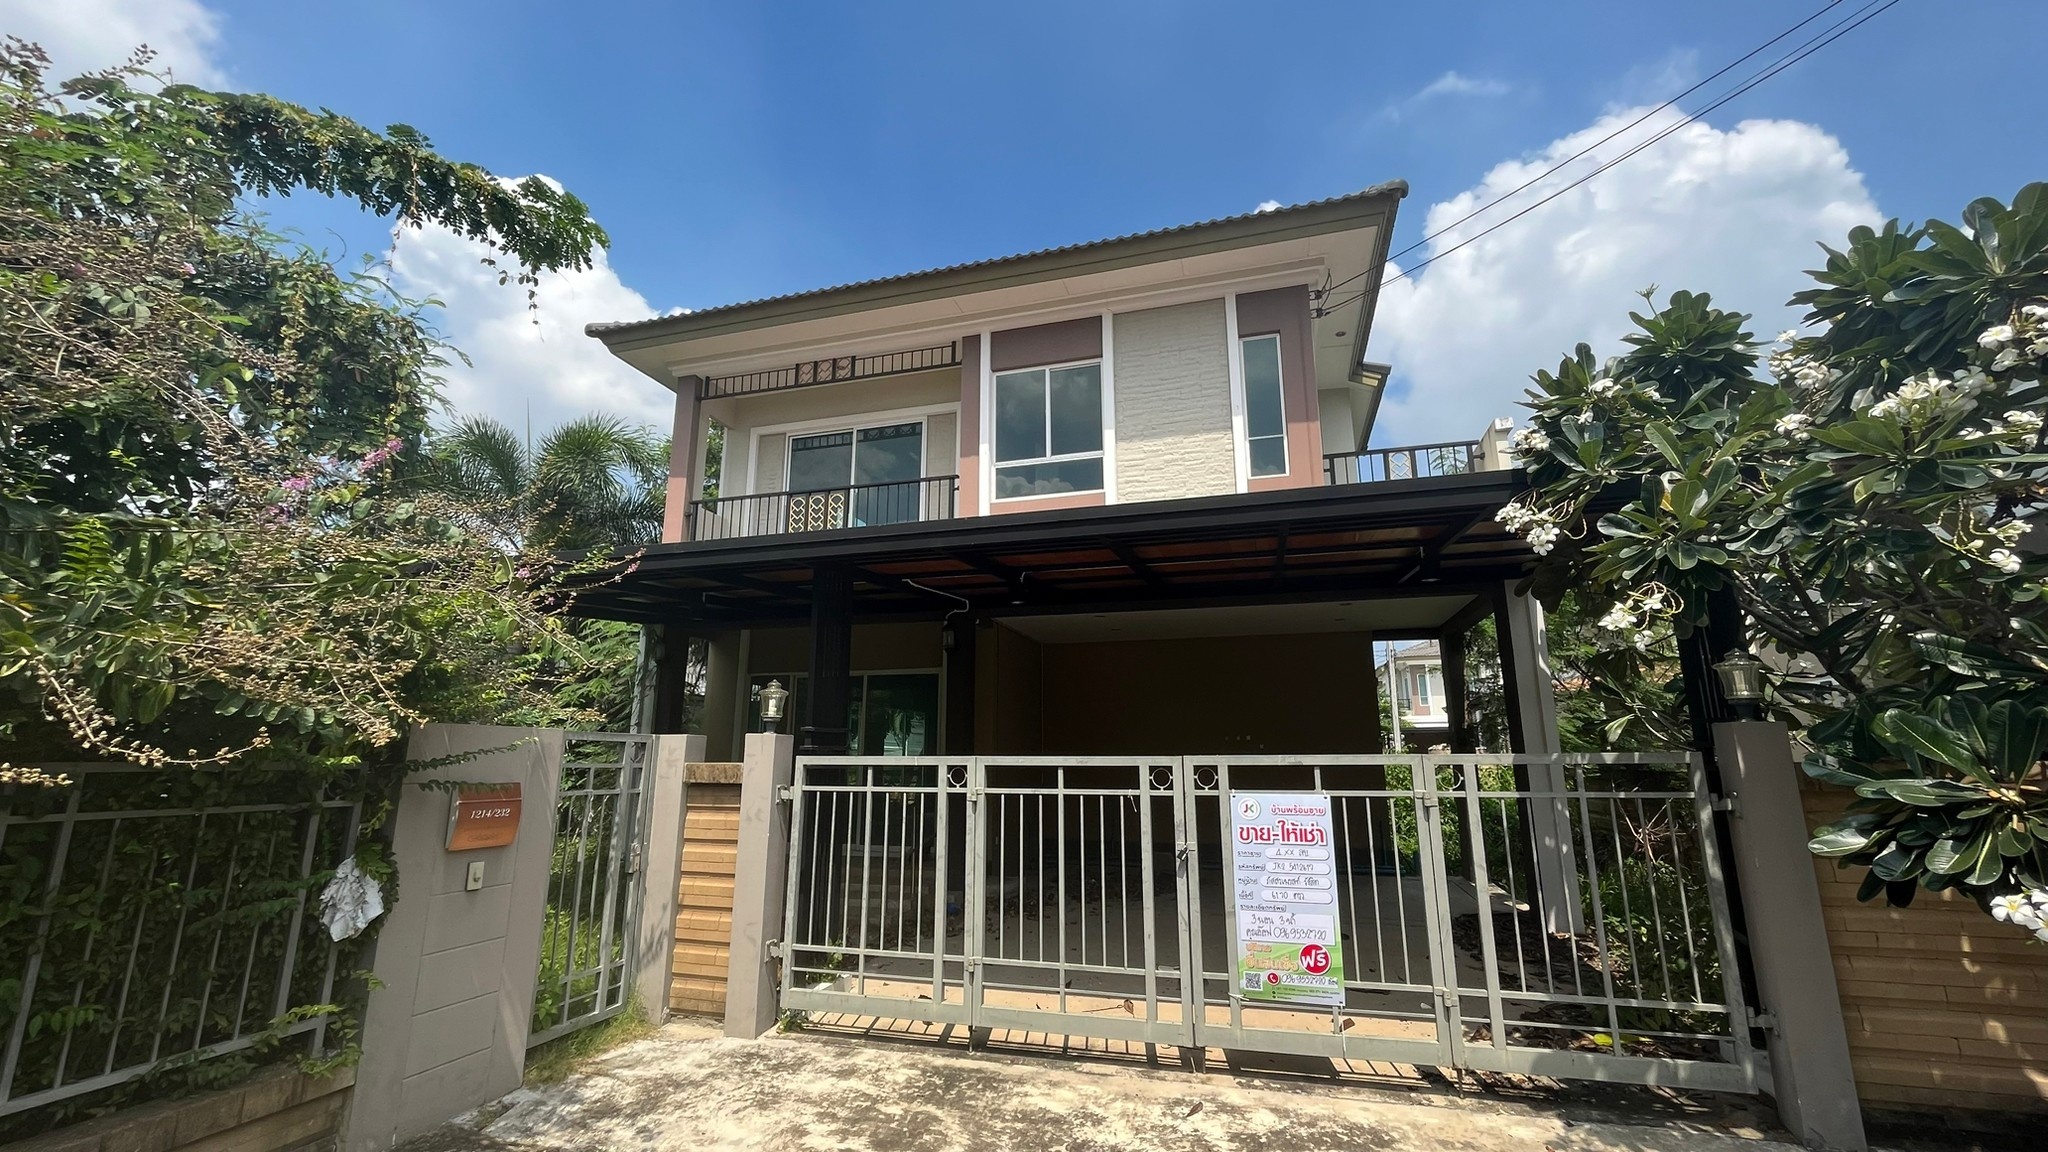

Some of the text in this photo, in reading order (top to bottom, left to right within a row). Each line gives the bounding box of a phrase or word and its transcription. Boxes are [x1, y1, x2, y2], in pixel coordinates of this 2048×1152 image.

[470, 808, 511, 819] 1214/232
[1239, 820, 1325, 843] ขาย-ให้เช่า
[1301, 949, 1326, 968] ฟรี
